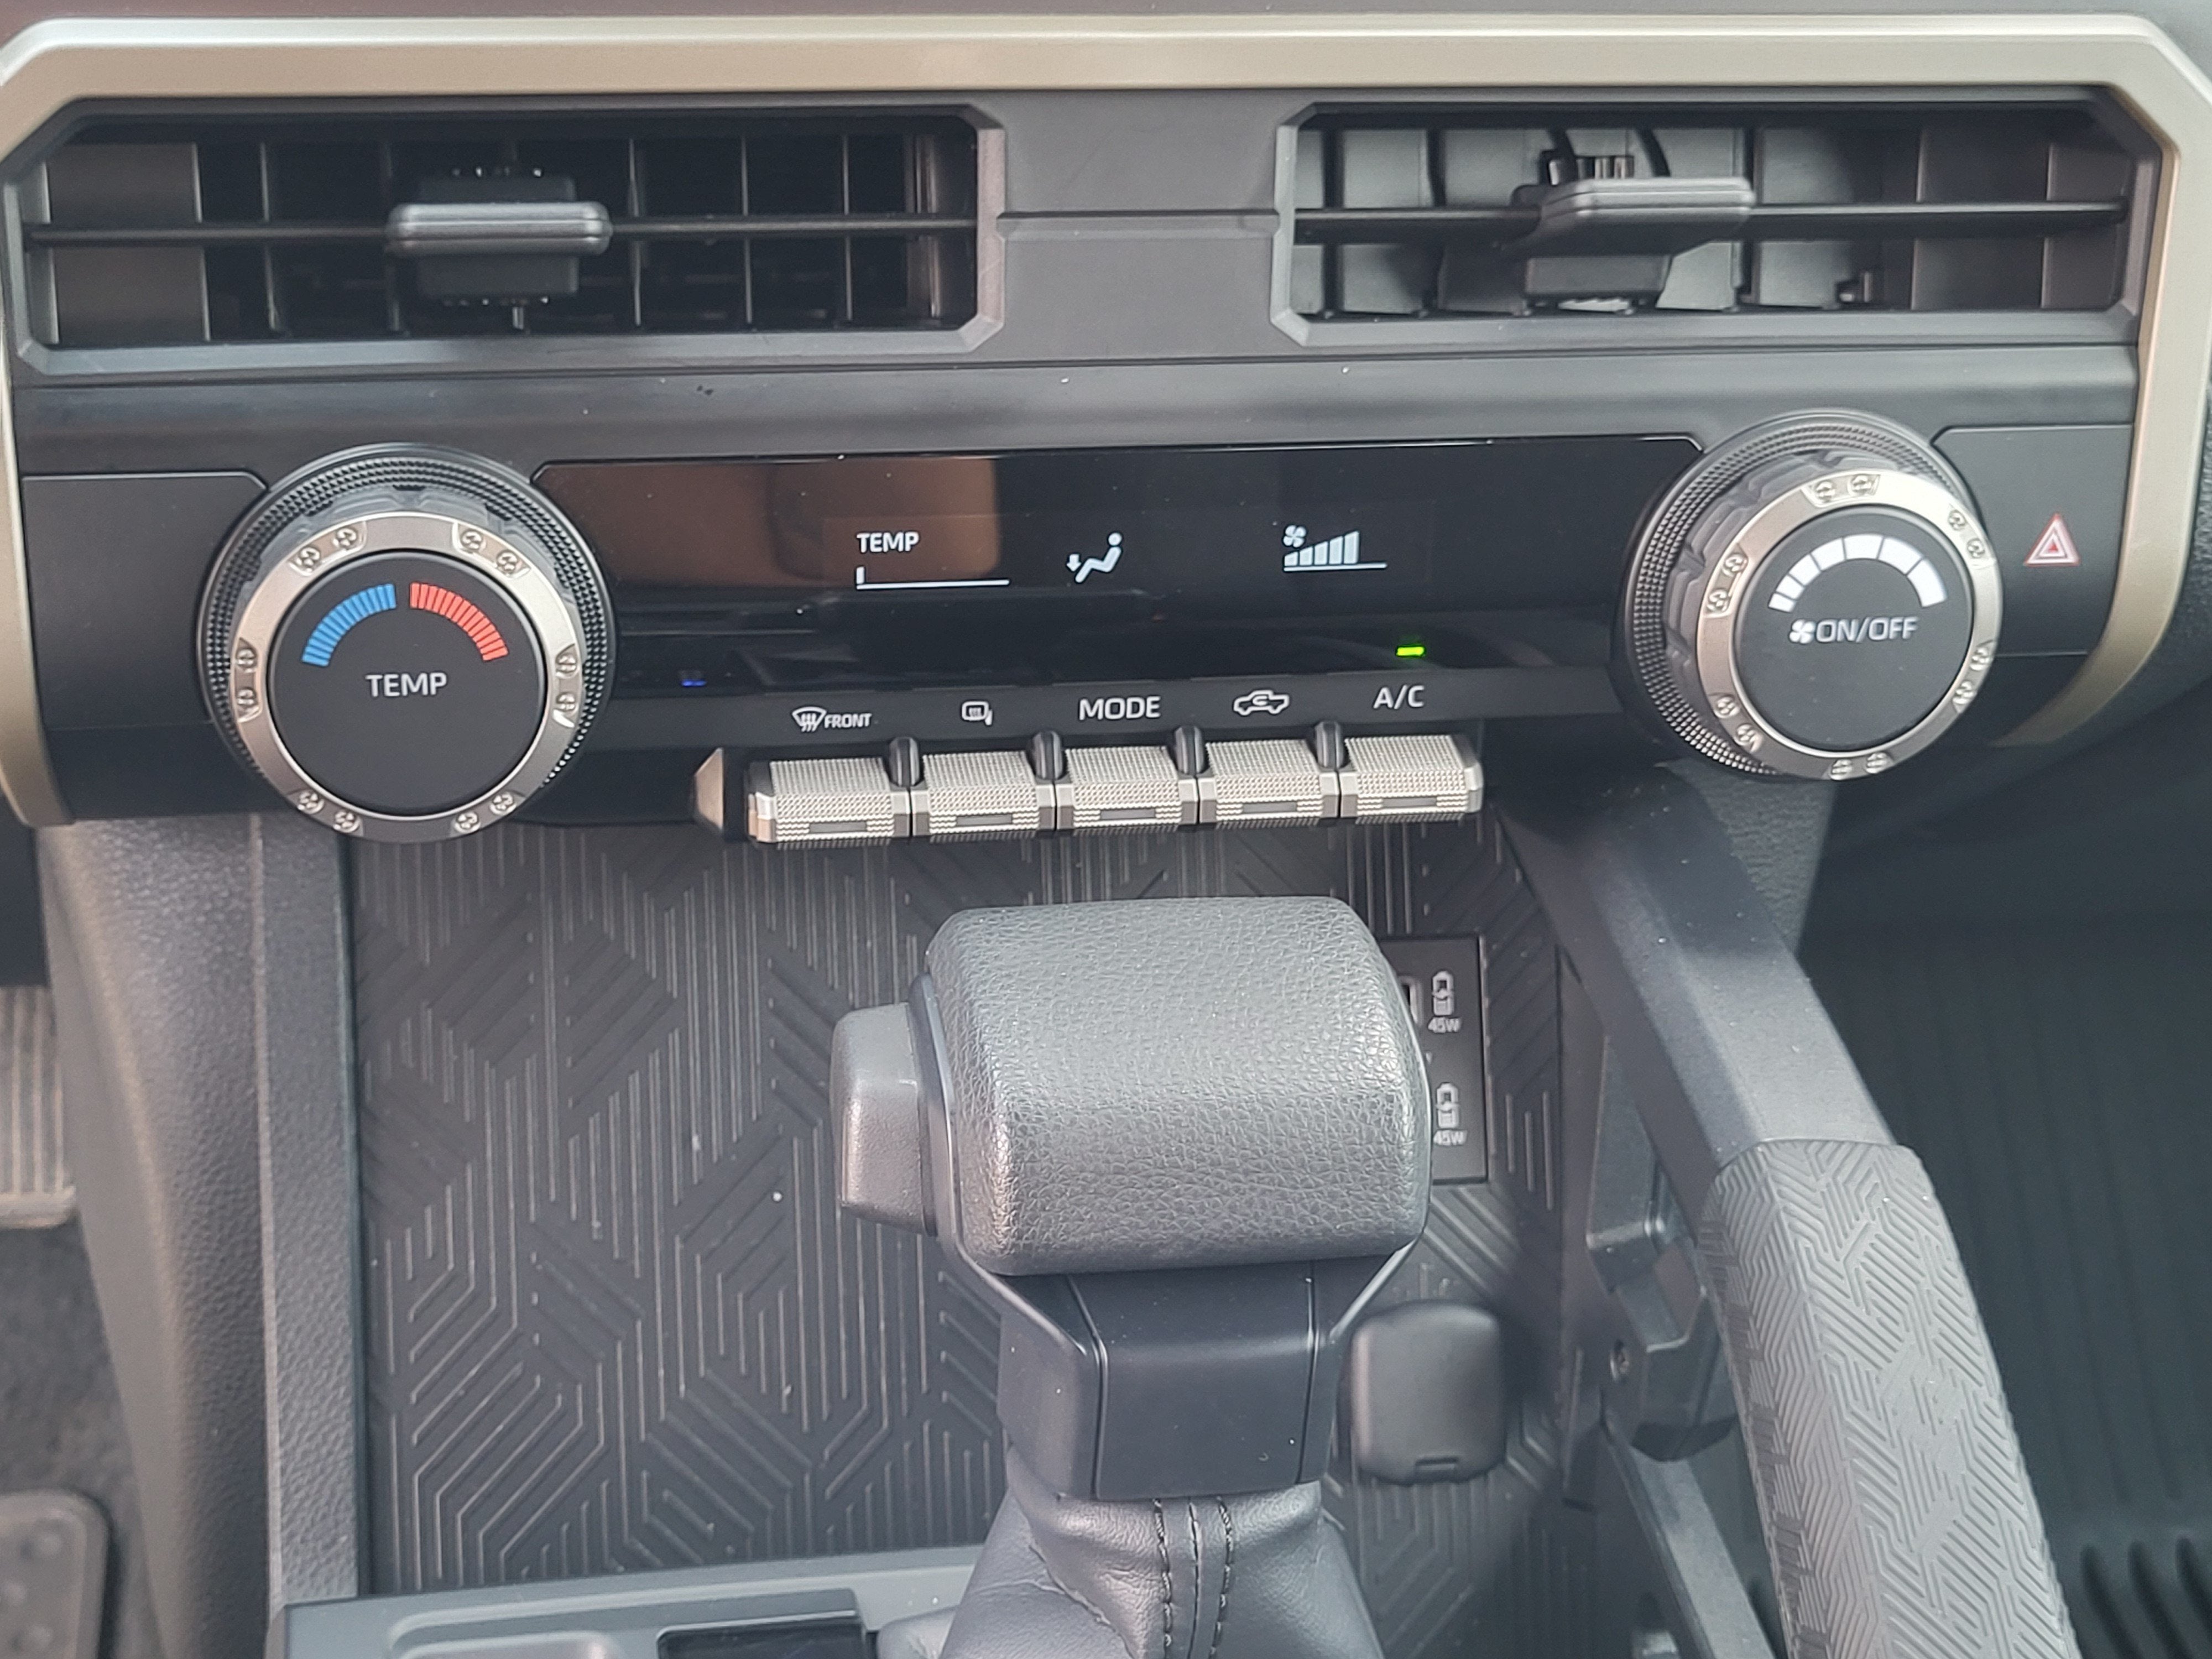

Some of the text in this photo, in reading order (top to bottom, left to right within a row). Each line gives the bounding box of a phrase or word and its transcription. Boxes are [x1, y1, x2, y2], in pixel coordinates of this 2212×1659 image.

[857, 532, 919, 552] TEMP
[1816, 617, 1918, 642] ON/OFF
[366, 673, 447, 697] TEMP
[1374, 685, 1425, 709] A/C
[1079, 696, 1161, 721] MODE
[825, 713, 872, 728] FRONT
[1428, 1016, 1461, 1033] 45W
[1433, 1130, 1467, 1145] 45W
